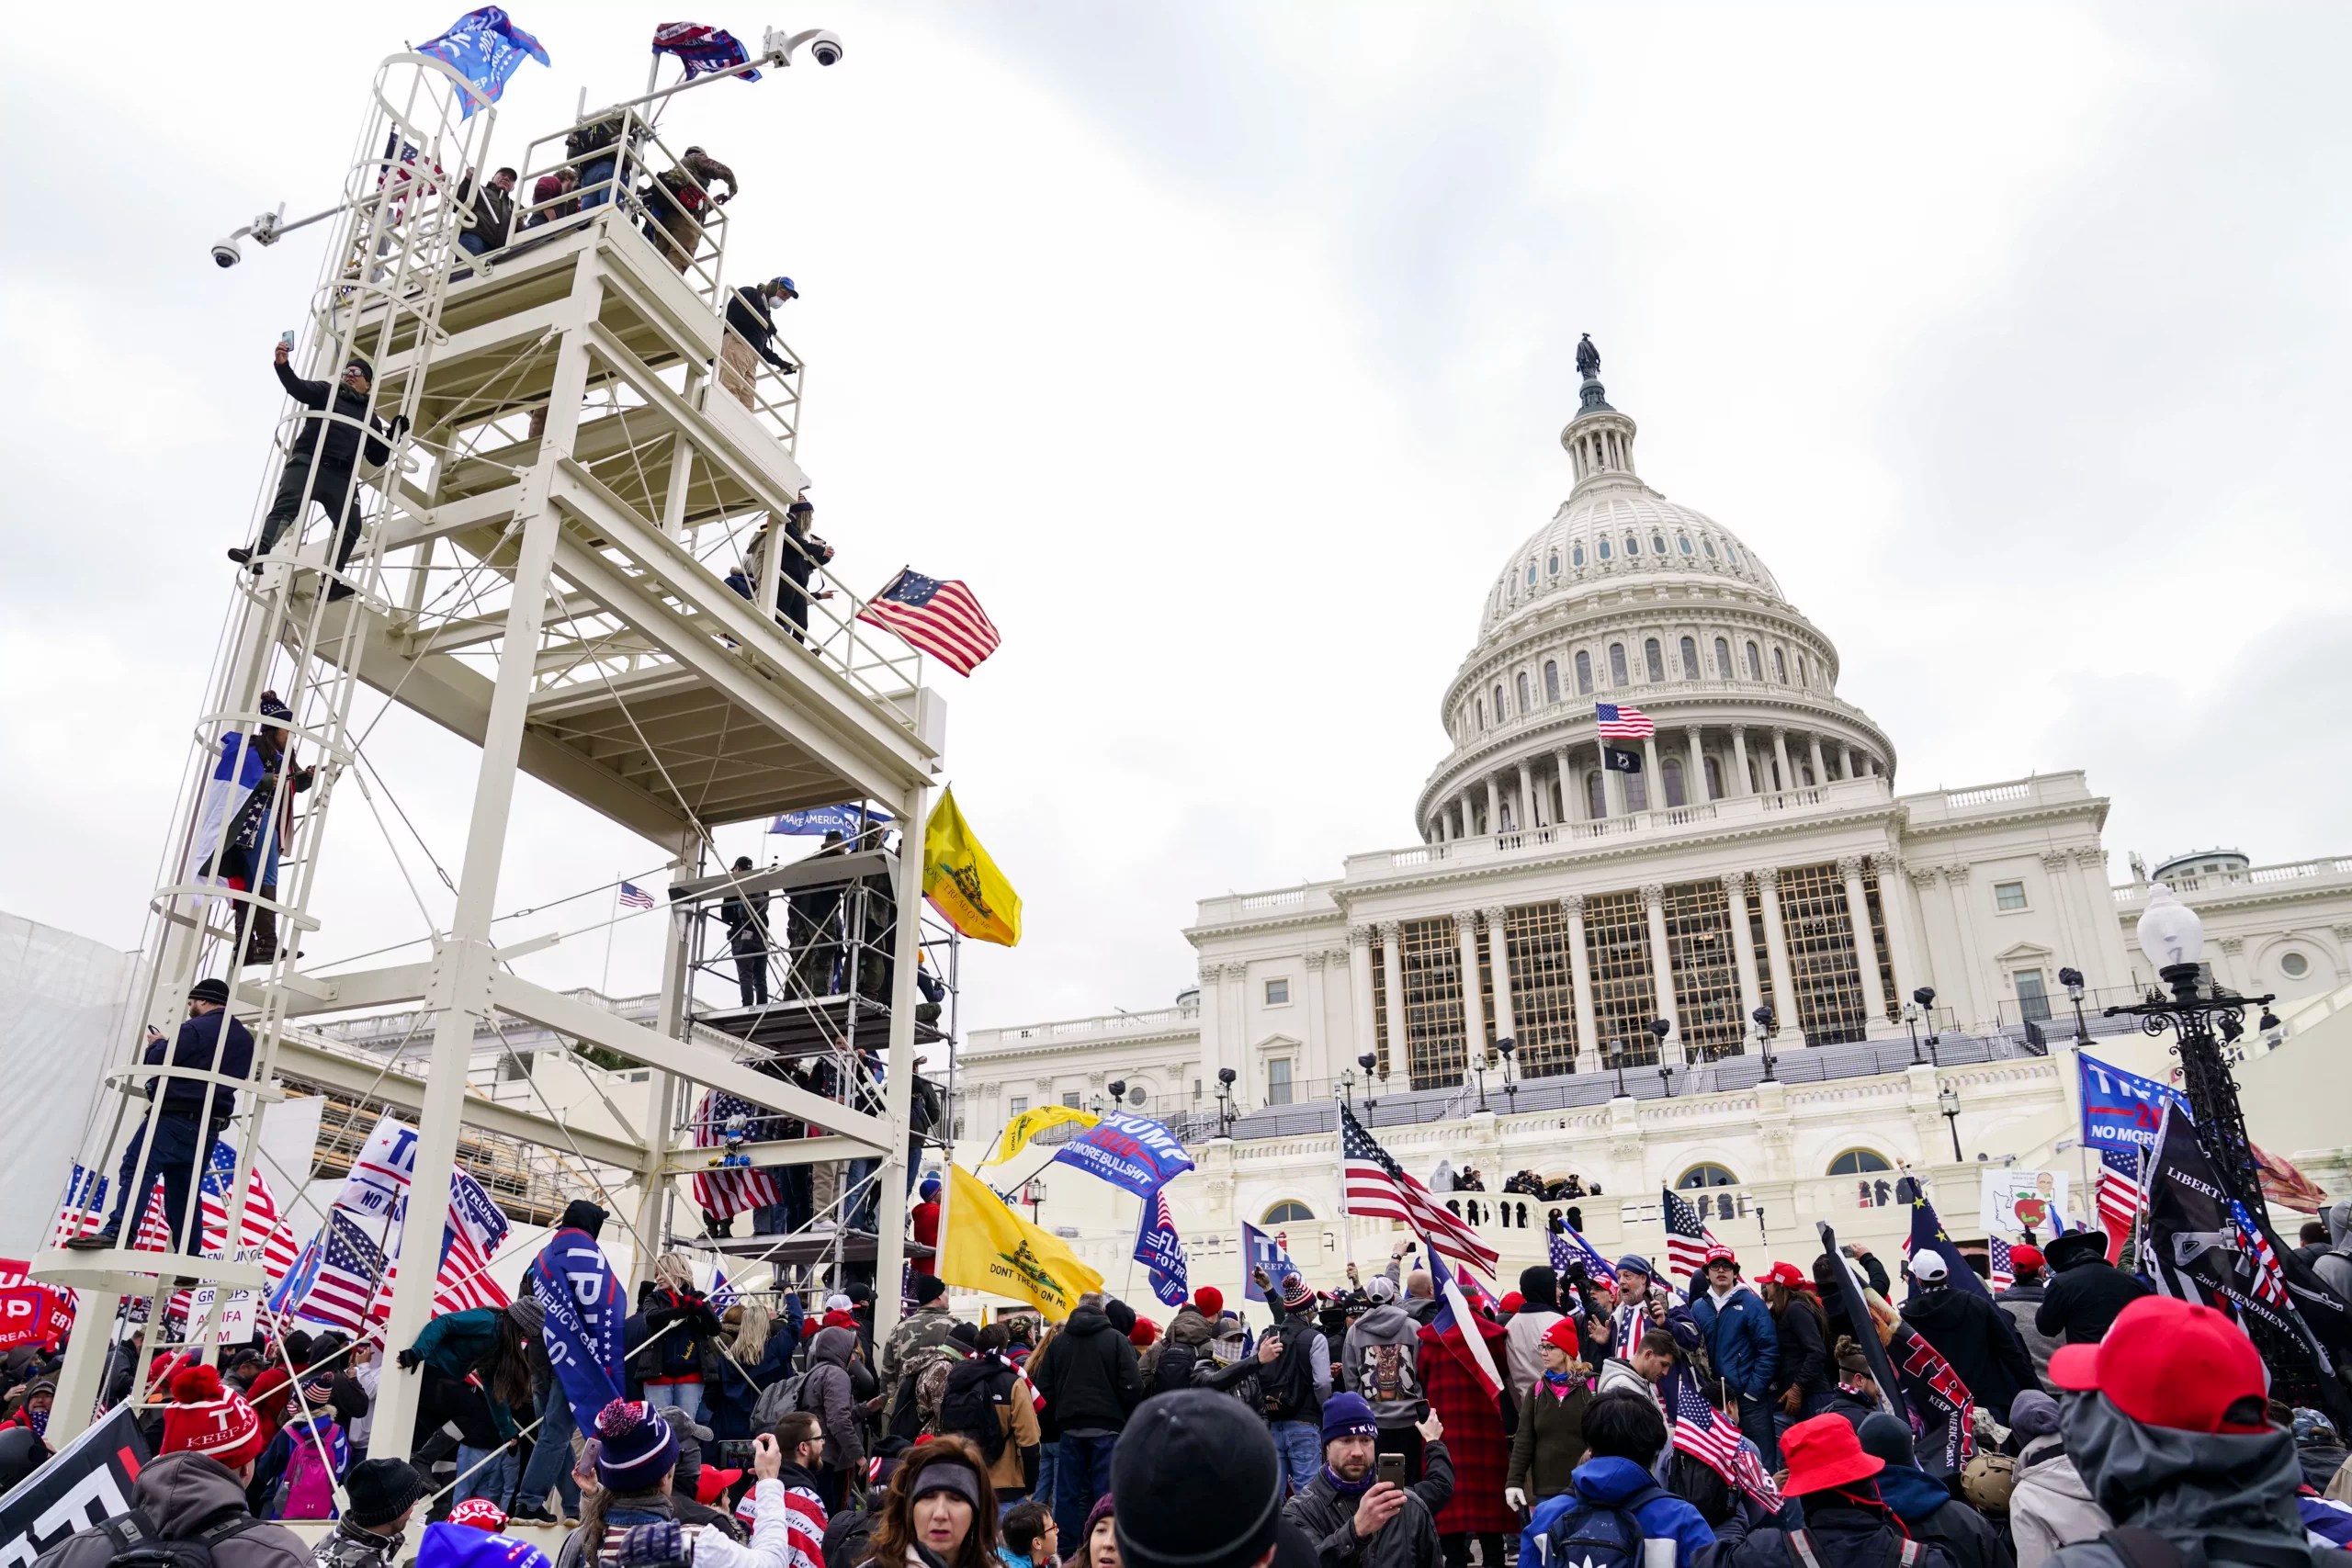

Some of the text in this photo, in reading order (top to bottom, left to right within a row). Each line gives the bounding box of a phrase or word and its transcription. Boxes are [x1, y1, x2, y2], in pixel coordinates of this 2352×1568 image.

[781, 813, 804, 827] MAKE
[804, 814, 844, 825] AMERICA
[2091, 1124, 2116, 1139] NO
[1073, 1141, 1102, 1162] MORE
[1102, 1152, 1153, 1185] BULLSHIT
[2166, 1166, 2231, 1205] LIBERTY
[360, 1190, 382, 1210] NO
[463, 1184, 500, 1231] TRUMP
[1155, 1252, 1176, 1270] FOR
[1256, 1262, 1283, 1270] KEEP
[989, 1264, 1067, 1310] DONT TREAD ON ME
[2195, 1271, 2218, 1289] 2nd
[2217, 1284, 2291, 1334] AMENDMENT
[1928, 1394, 1952, 1413] KEEP
[186, 1427, 240, 1448] KEEP
